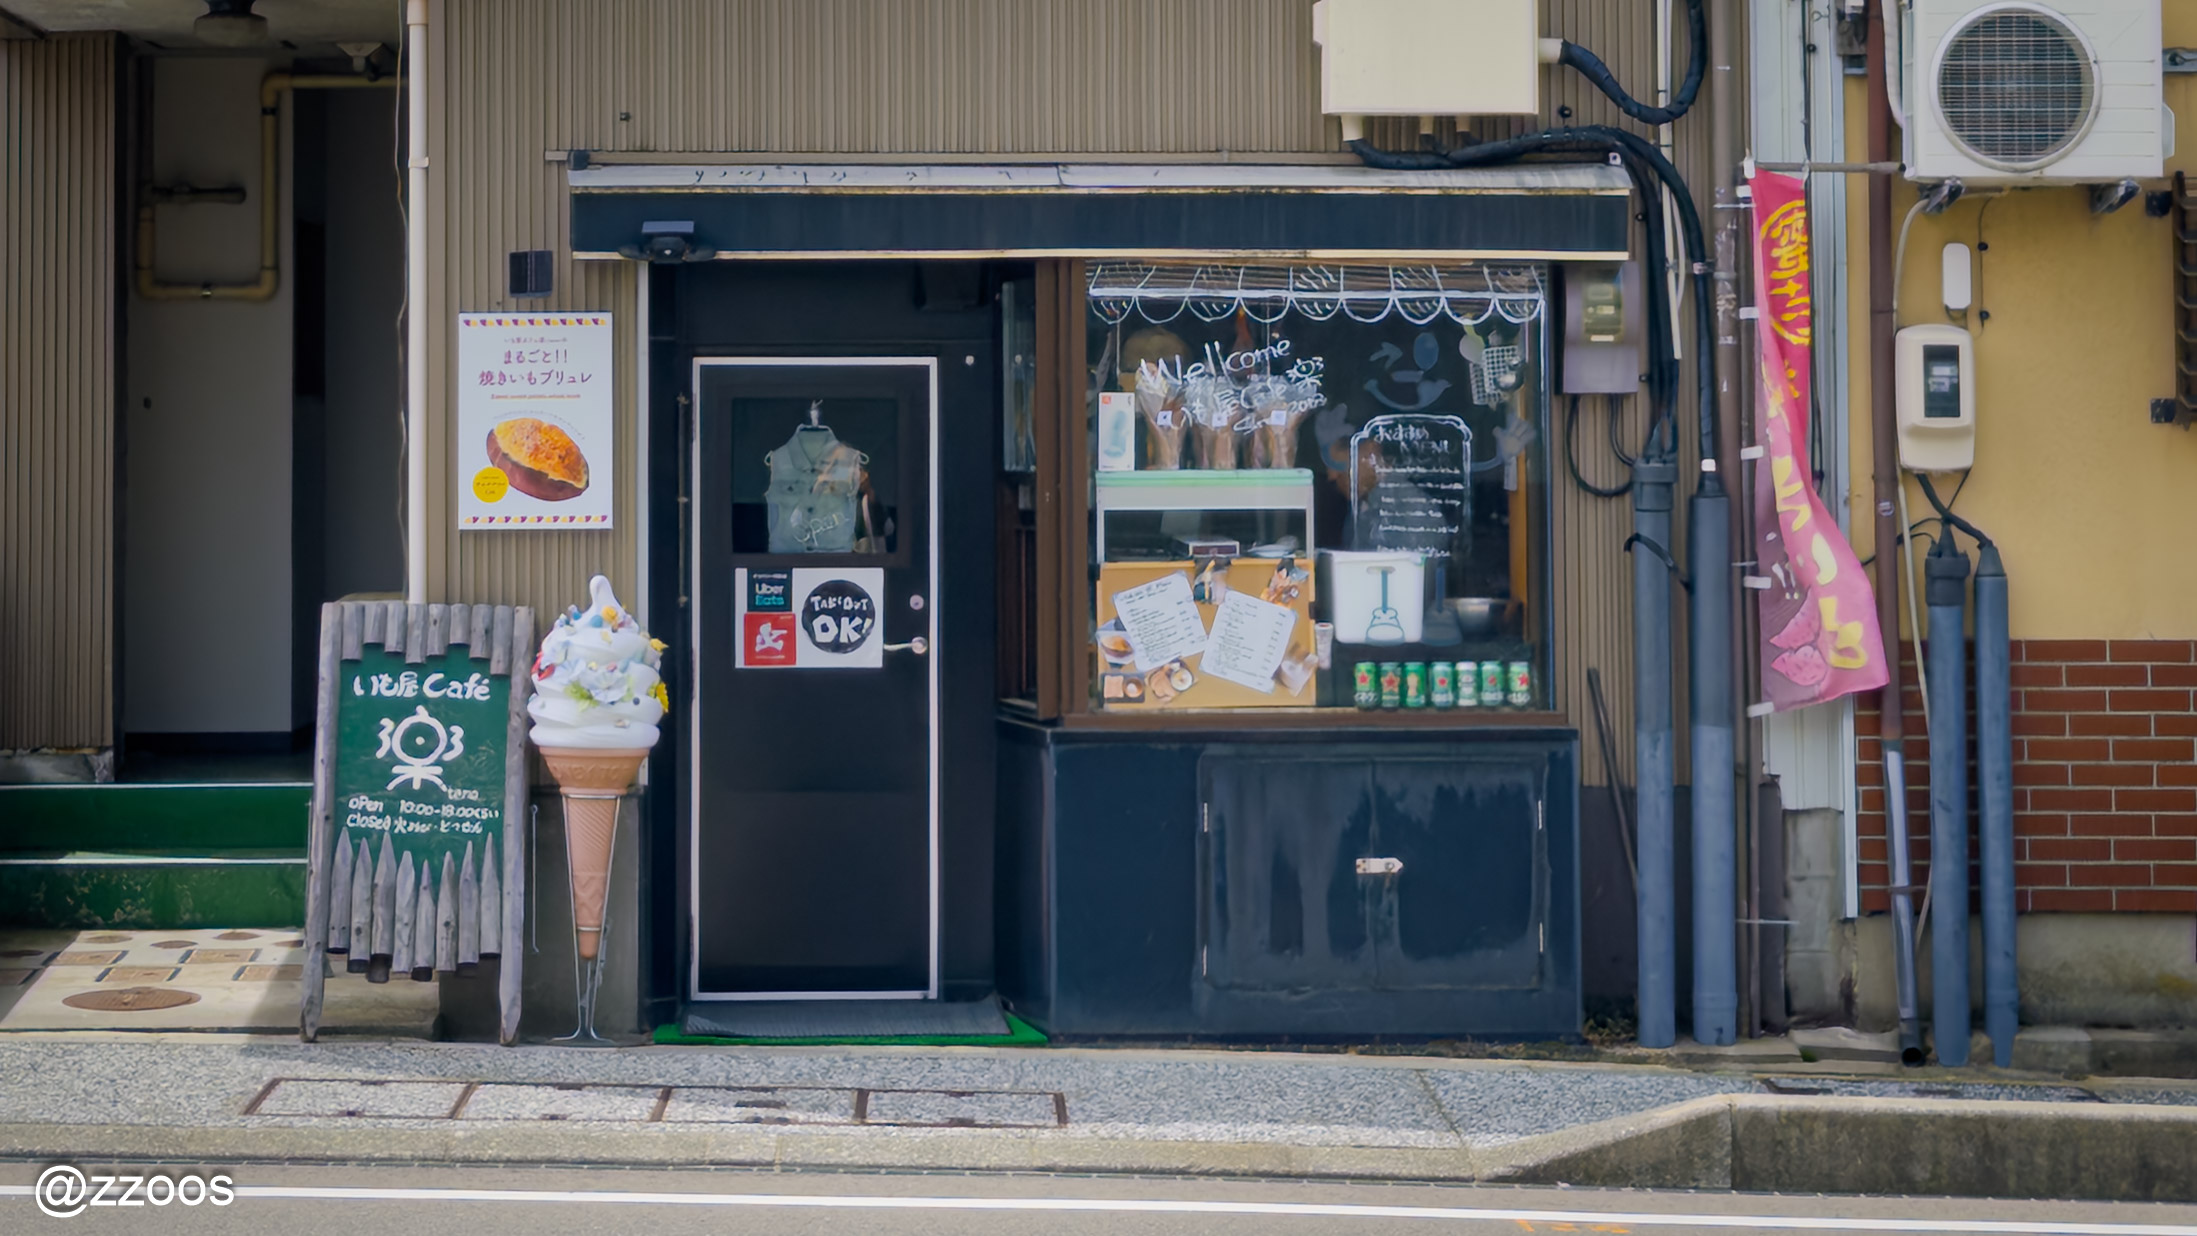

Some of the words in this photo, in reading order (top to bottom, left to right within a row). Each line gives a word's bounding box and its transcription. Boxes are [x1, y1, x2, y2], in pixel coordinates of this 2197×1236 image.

[478, 369, 592, 386] 焼きいもブリュレ
[755, 582, 784, 595] Uber
[755, 594, 785, 606] Eats
[812, 614, 873, 644] OK!
[422, 672, 491, 701] Café
